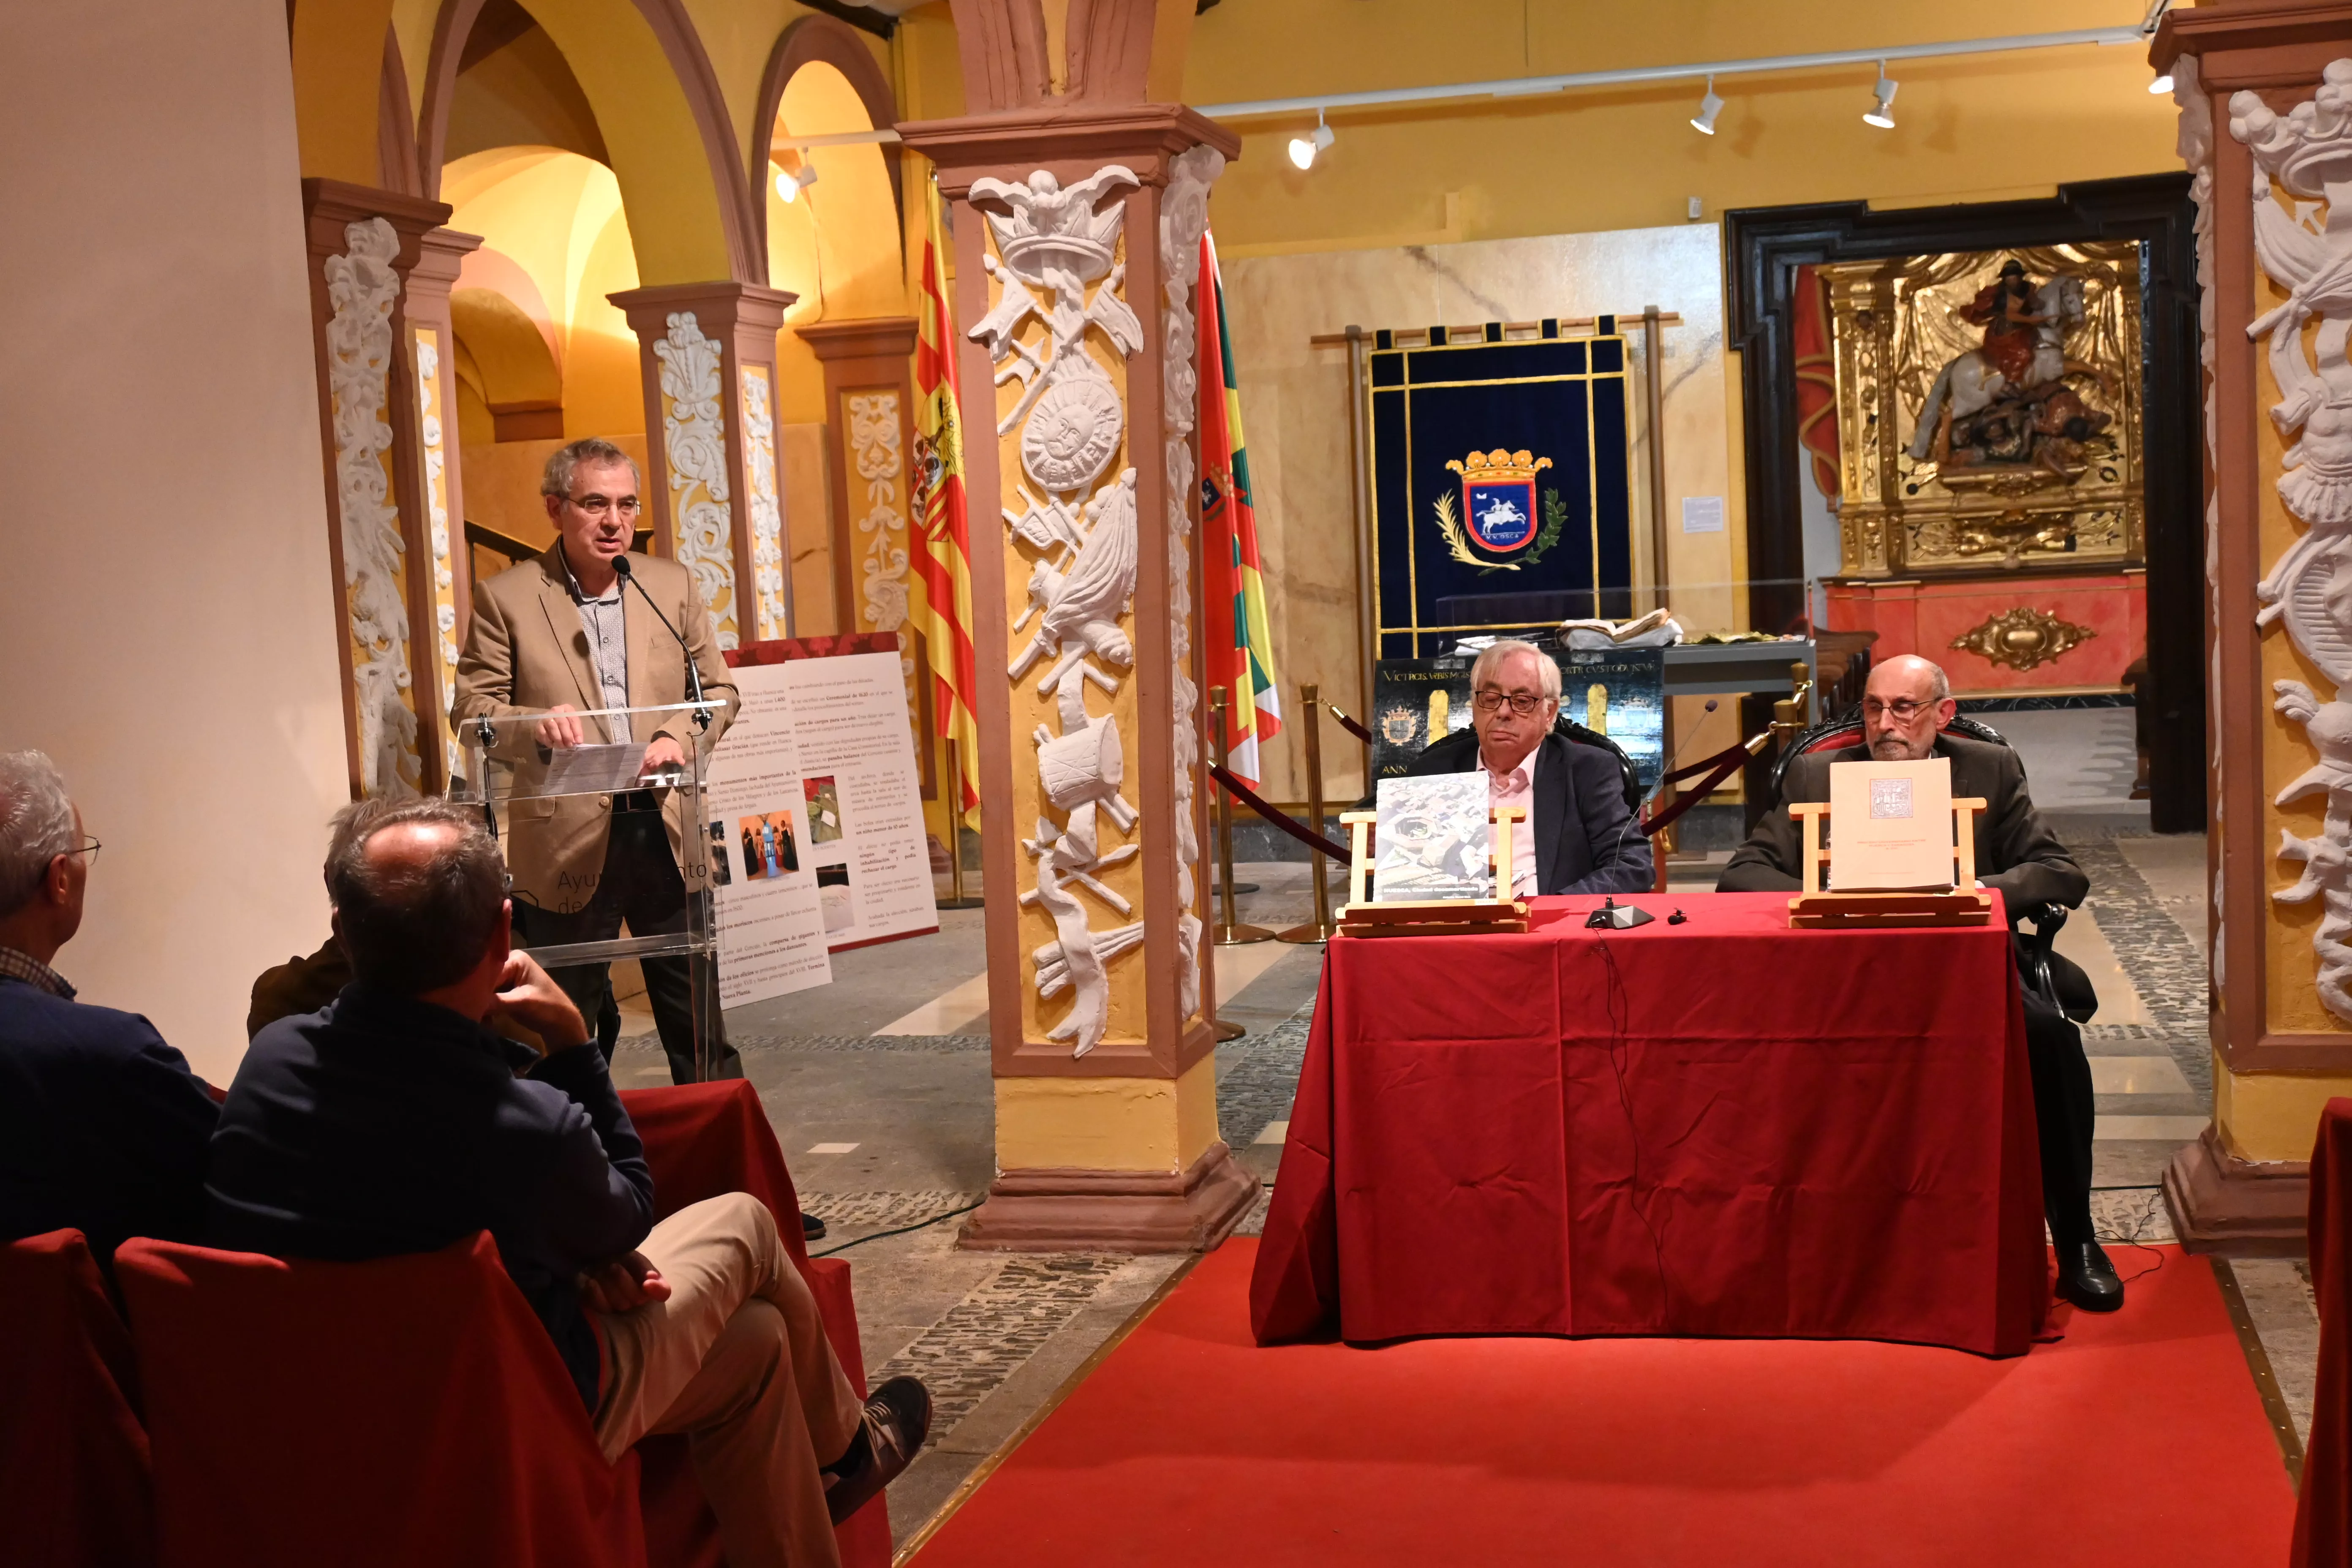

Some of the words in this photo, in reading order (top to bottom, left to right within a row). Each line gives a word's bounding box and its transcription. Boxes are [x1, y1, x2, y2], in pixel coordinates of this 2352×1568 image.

[719, 777, 746, 785] monumentos
[759, 772, 783, 780] importantes
[860, 857, 890, 866] inhabilitación
[734, 920, 752, 928] moriscos
[769, 938, 789, 946] comparsa
[799, 931, 815, 940] gigantes
[734, 954, 753, 964] primeras
[754, 949, 776, 958] menciones
